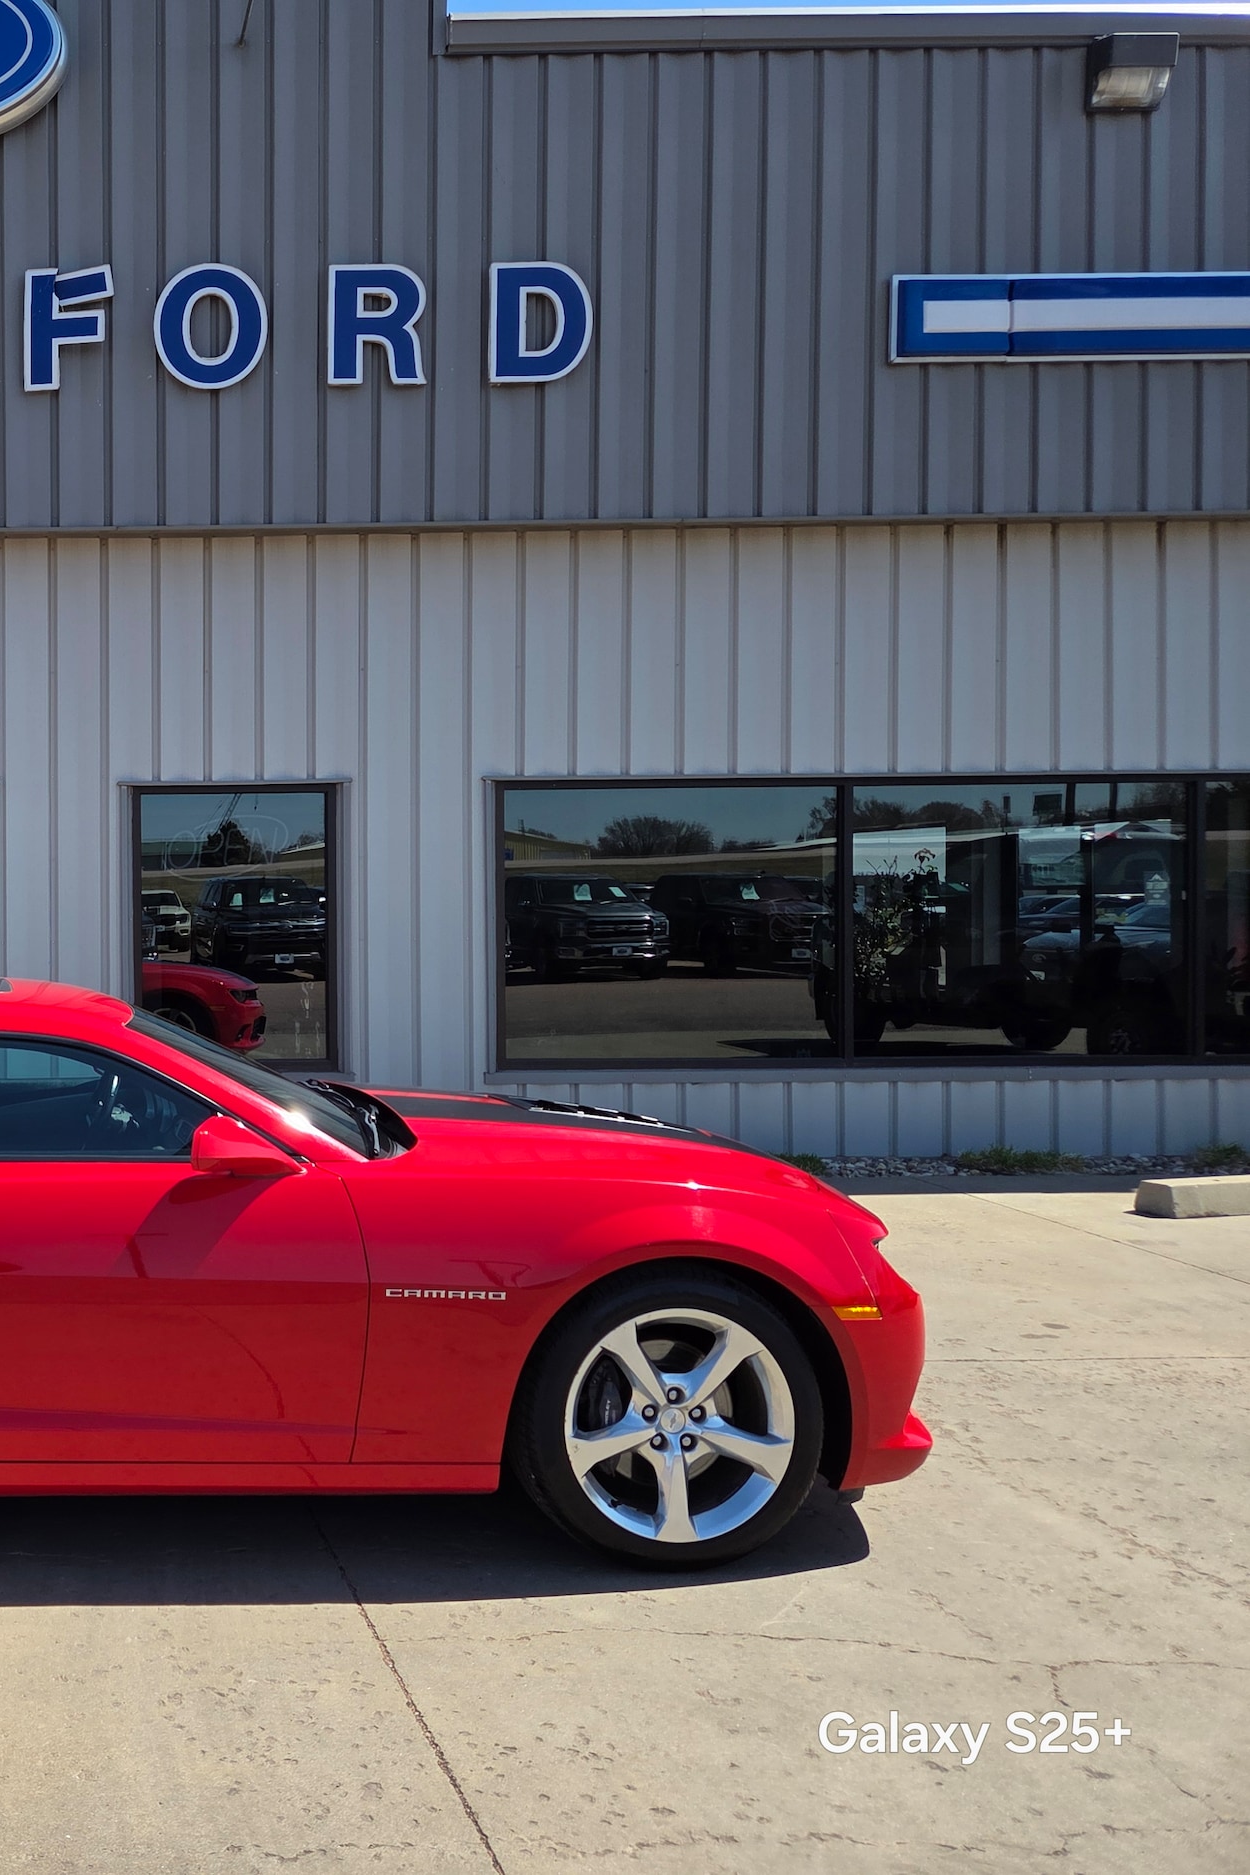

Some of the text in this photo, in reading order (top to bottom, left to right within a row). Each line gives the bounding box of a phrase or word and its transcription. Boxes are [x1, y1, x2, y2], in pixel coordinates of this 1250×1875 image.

[23, 261, 594, 391] FORD
[168, 827, 279, 869] OPEN
[385, 1288, 507, 1301] CAMARO
